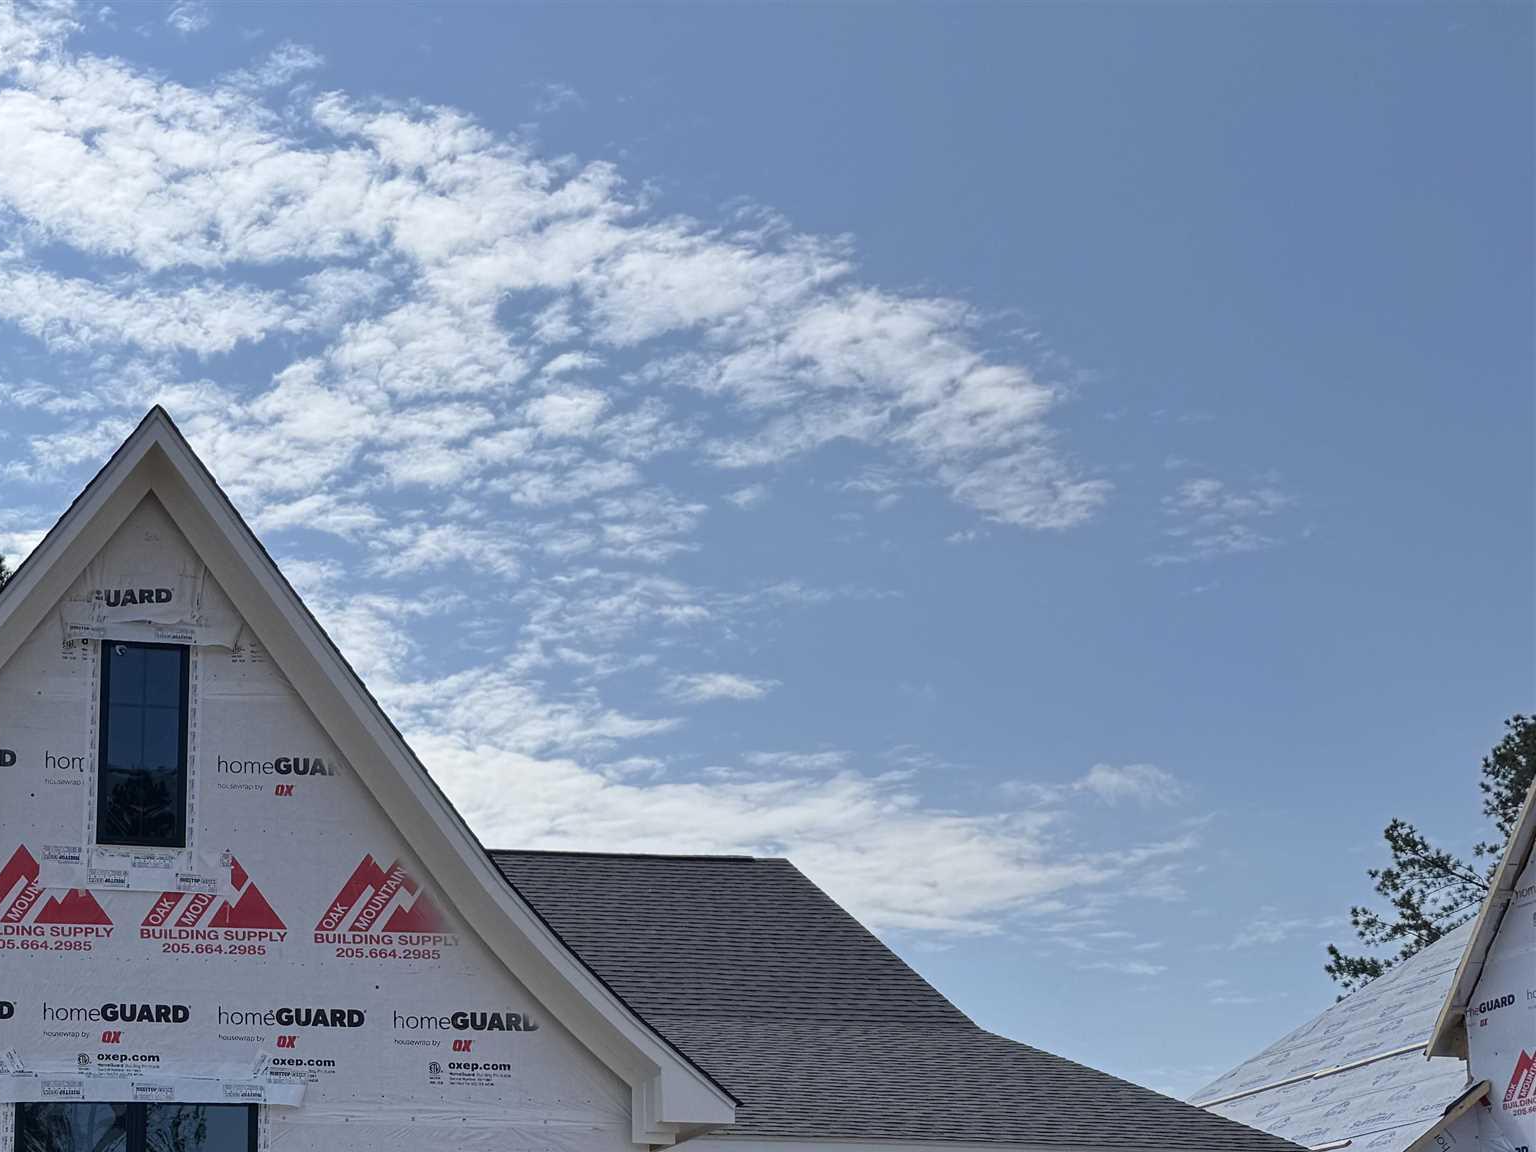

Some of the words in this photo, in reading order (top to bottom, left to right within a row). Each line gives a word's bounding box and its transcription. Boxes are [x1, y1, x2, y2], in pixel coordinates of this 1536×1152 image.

[275, 784, 294, 796] OX
[355, 866, 408, 932] MOUNTAIN
[149, 897, 176, 925] OAK
[323, 903, 349, 930] OAK
[50, 926, 114, 938] SUPPLY
[140, 928, 219, 940] BUILDING
[223, 930, 288, 942] SUPPLY
[314, 933, 393, 945] BUILDING
[398, 934, 460, 947] SUPPLY
[162, 943, 266, 956] 205.664.2985
[335, 948, 441, 960] 205.664.2985
[42, 1002, 190, 1024] homeGUARD
[217, 1006, 365, 1028] homeGUARD
[102, 1030, 122, 1043] OX
[277, 1035, 297, 1048] OX
[452, 1039, 473, 1052] OX
[97, 1053, 160, 1062] oxep.com
[448, 1062, 511, 1071] oxep.com
[1506, 1084, 1517, 1101] OAK
